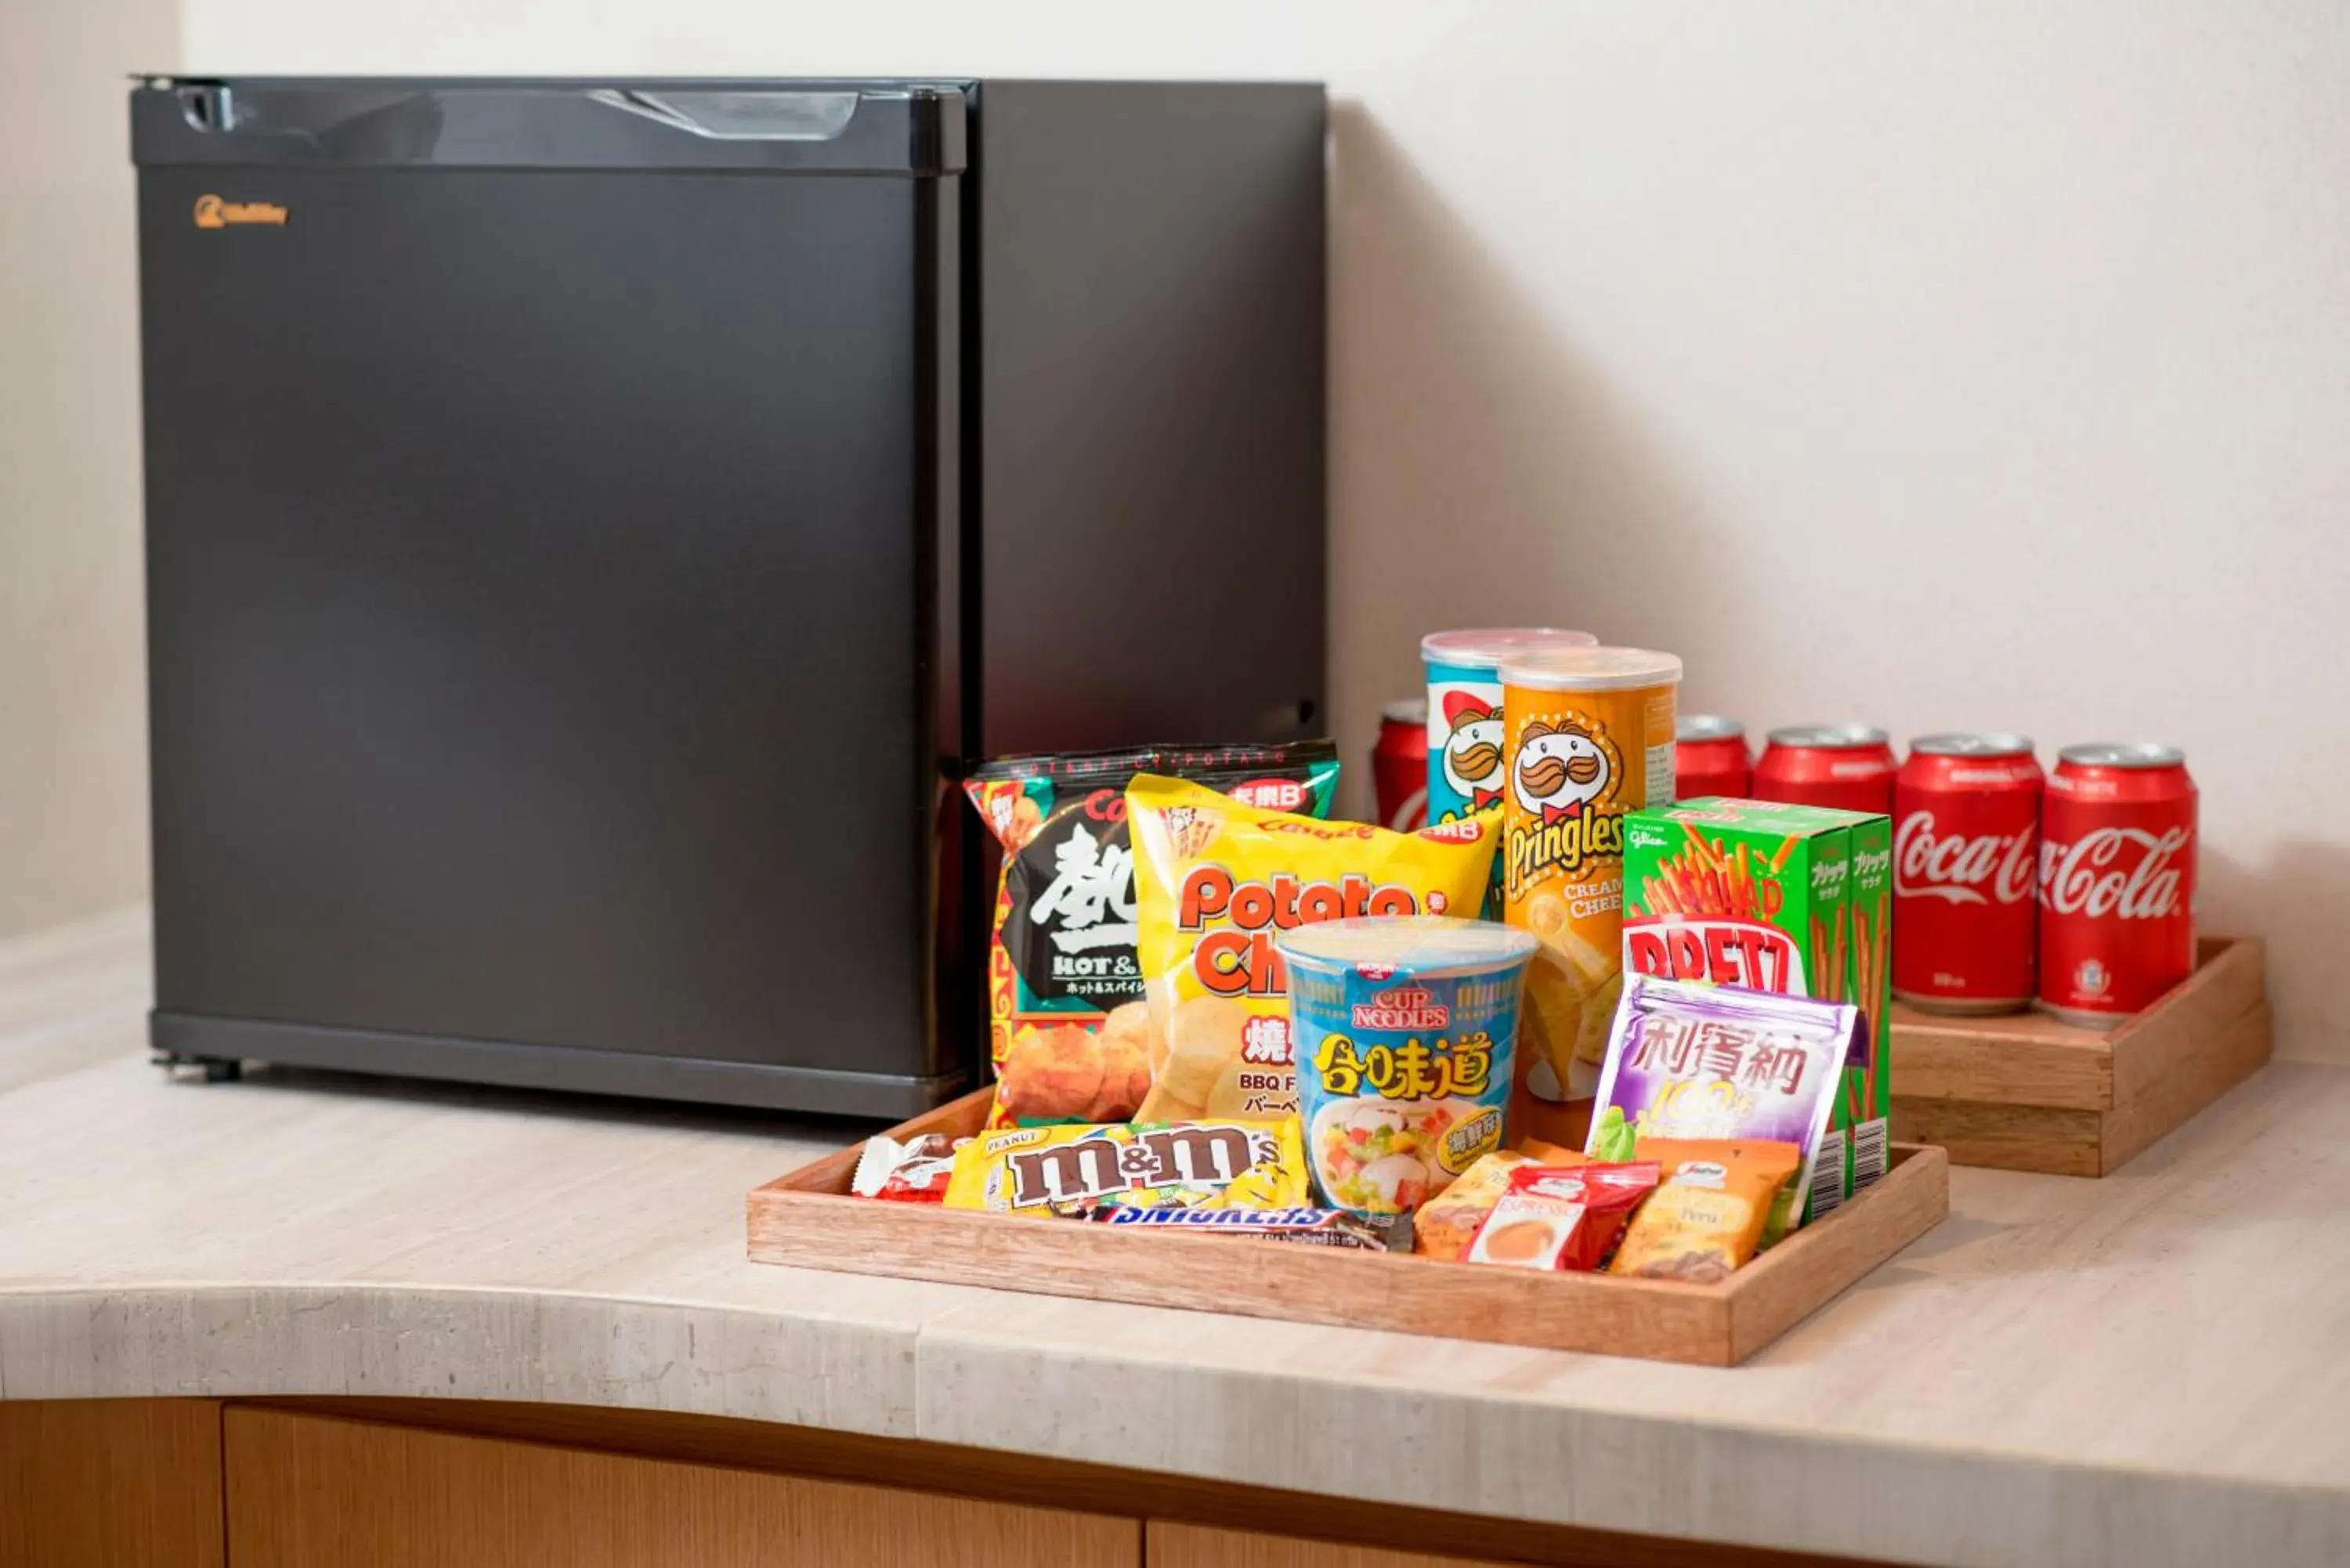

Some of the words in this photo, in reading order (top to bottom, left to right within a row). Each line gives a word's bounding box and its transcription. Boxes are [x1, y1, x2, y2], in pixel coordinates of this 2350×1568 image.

[1511, 805, 1623, 891] Pringles
[1177, 864, 1421, 932] Potato
[1053, 956, 1112, 975] HOT
[1113, 956, 1136, 975] &
[1374, 990, 1429, 1009] CUP
[1354, 1007, 1448, 1029] NOODLES
[1243, 1018, 1295, 1062] 燒
[1631, 1017, 1808, 1094] 利賓納
[1314, 1032, 1492, 1099] 合味道
[1240, 1075, 1279, 1090] BBQ
[1245, 1096, 1300, 1113] バーベ
[988, 1131, 1036, 1151] PEANUT
[1007, 1125, 1282, 1209] m&m's
